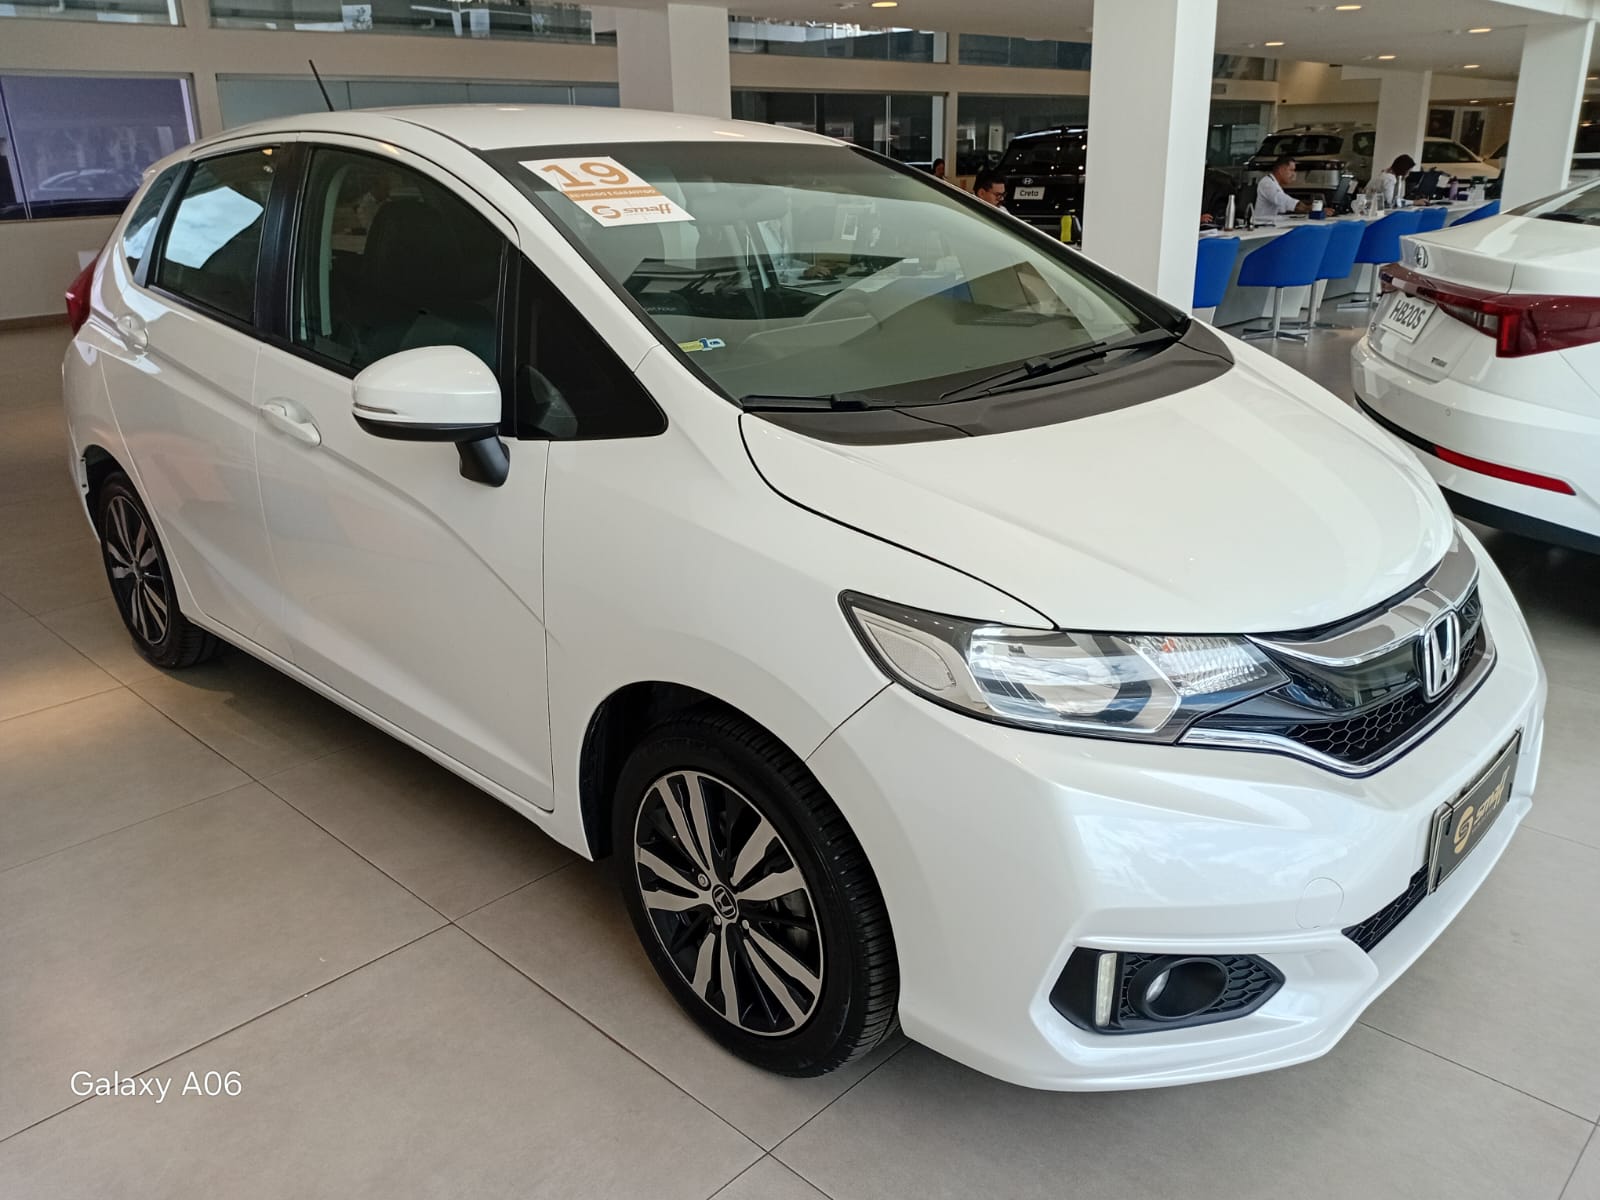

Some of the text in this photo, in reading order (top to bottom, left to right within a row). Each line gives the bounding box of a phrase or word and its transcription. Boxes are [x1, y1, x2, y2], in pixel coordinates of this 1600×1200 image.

[541, 161, 630, 188] 19
[623, 203, 672, 215] smaff
[1389, 300, 1426, 330] HB20S
